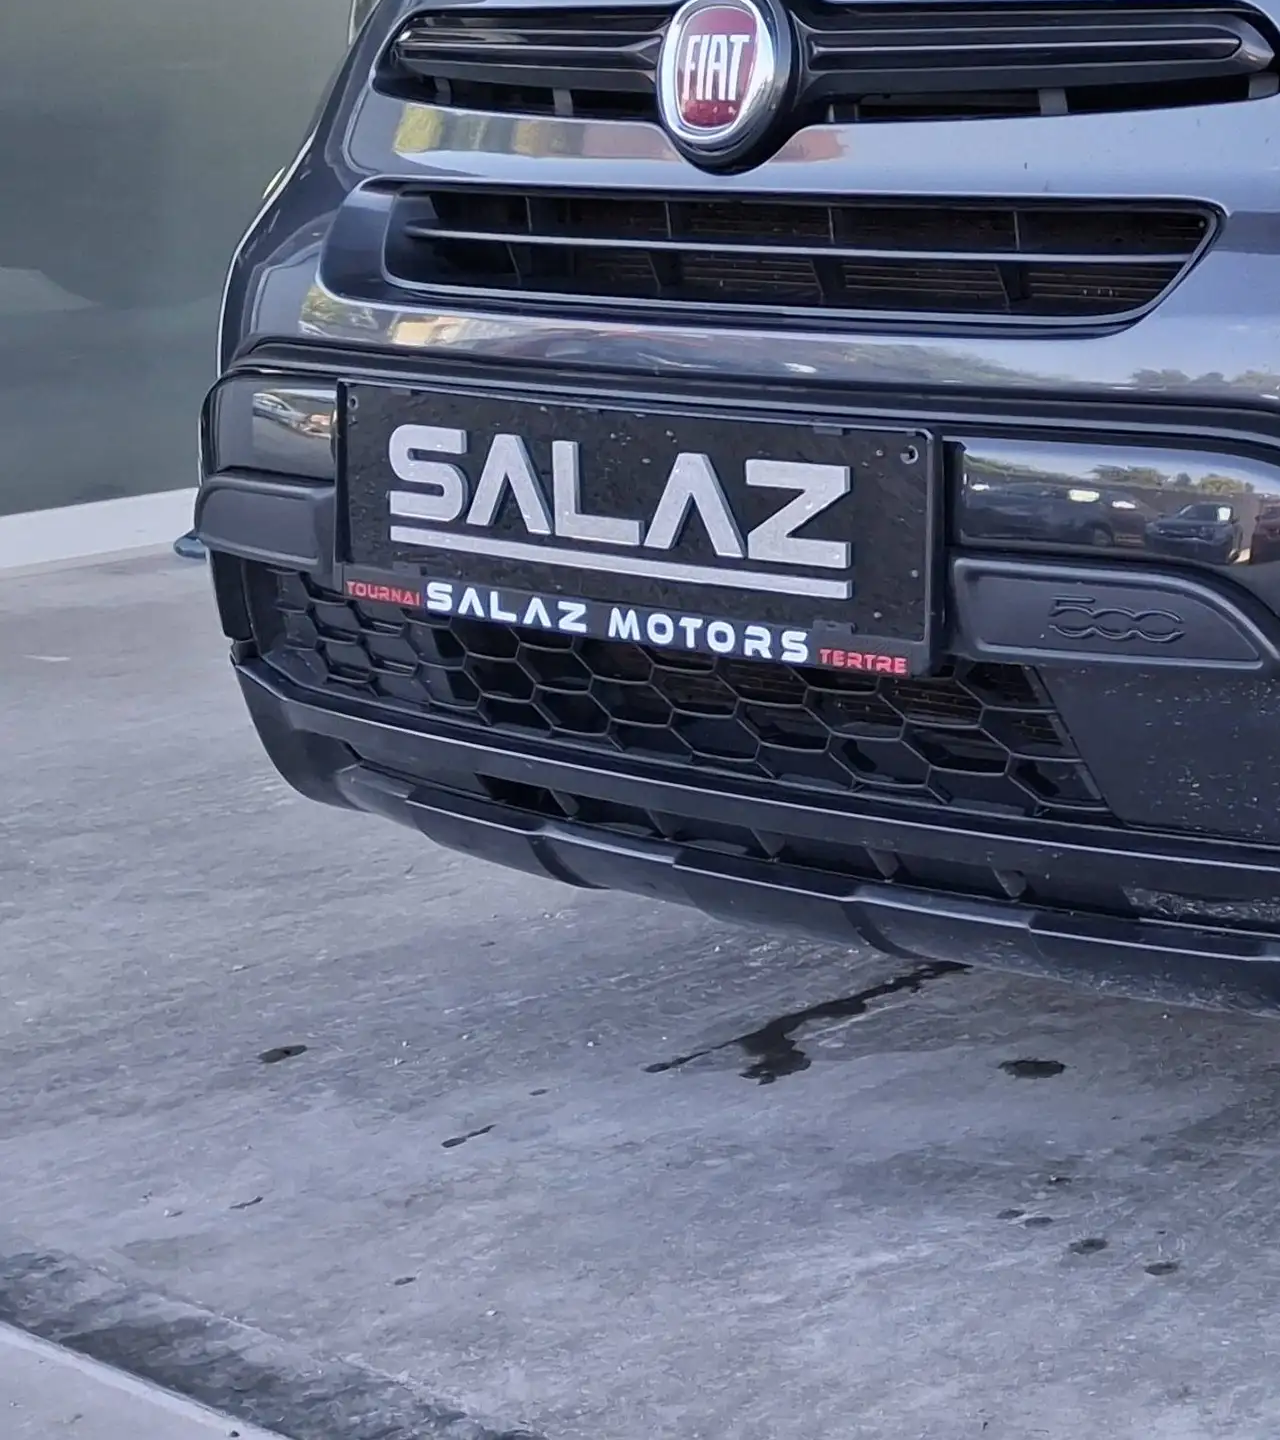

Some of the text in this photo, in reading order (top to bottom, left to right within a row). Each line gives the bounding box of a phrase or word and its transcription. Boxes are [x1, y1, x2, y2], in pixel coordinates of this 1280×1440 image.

[682, 34, 750, 101] FIAT
[388, 423, 851, 569] SALAZ
[346, 579, 908, 674] TOURNAI SALAZ MOTORS TERTRE
[1048, 594, 1185, 643] 500
